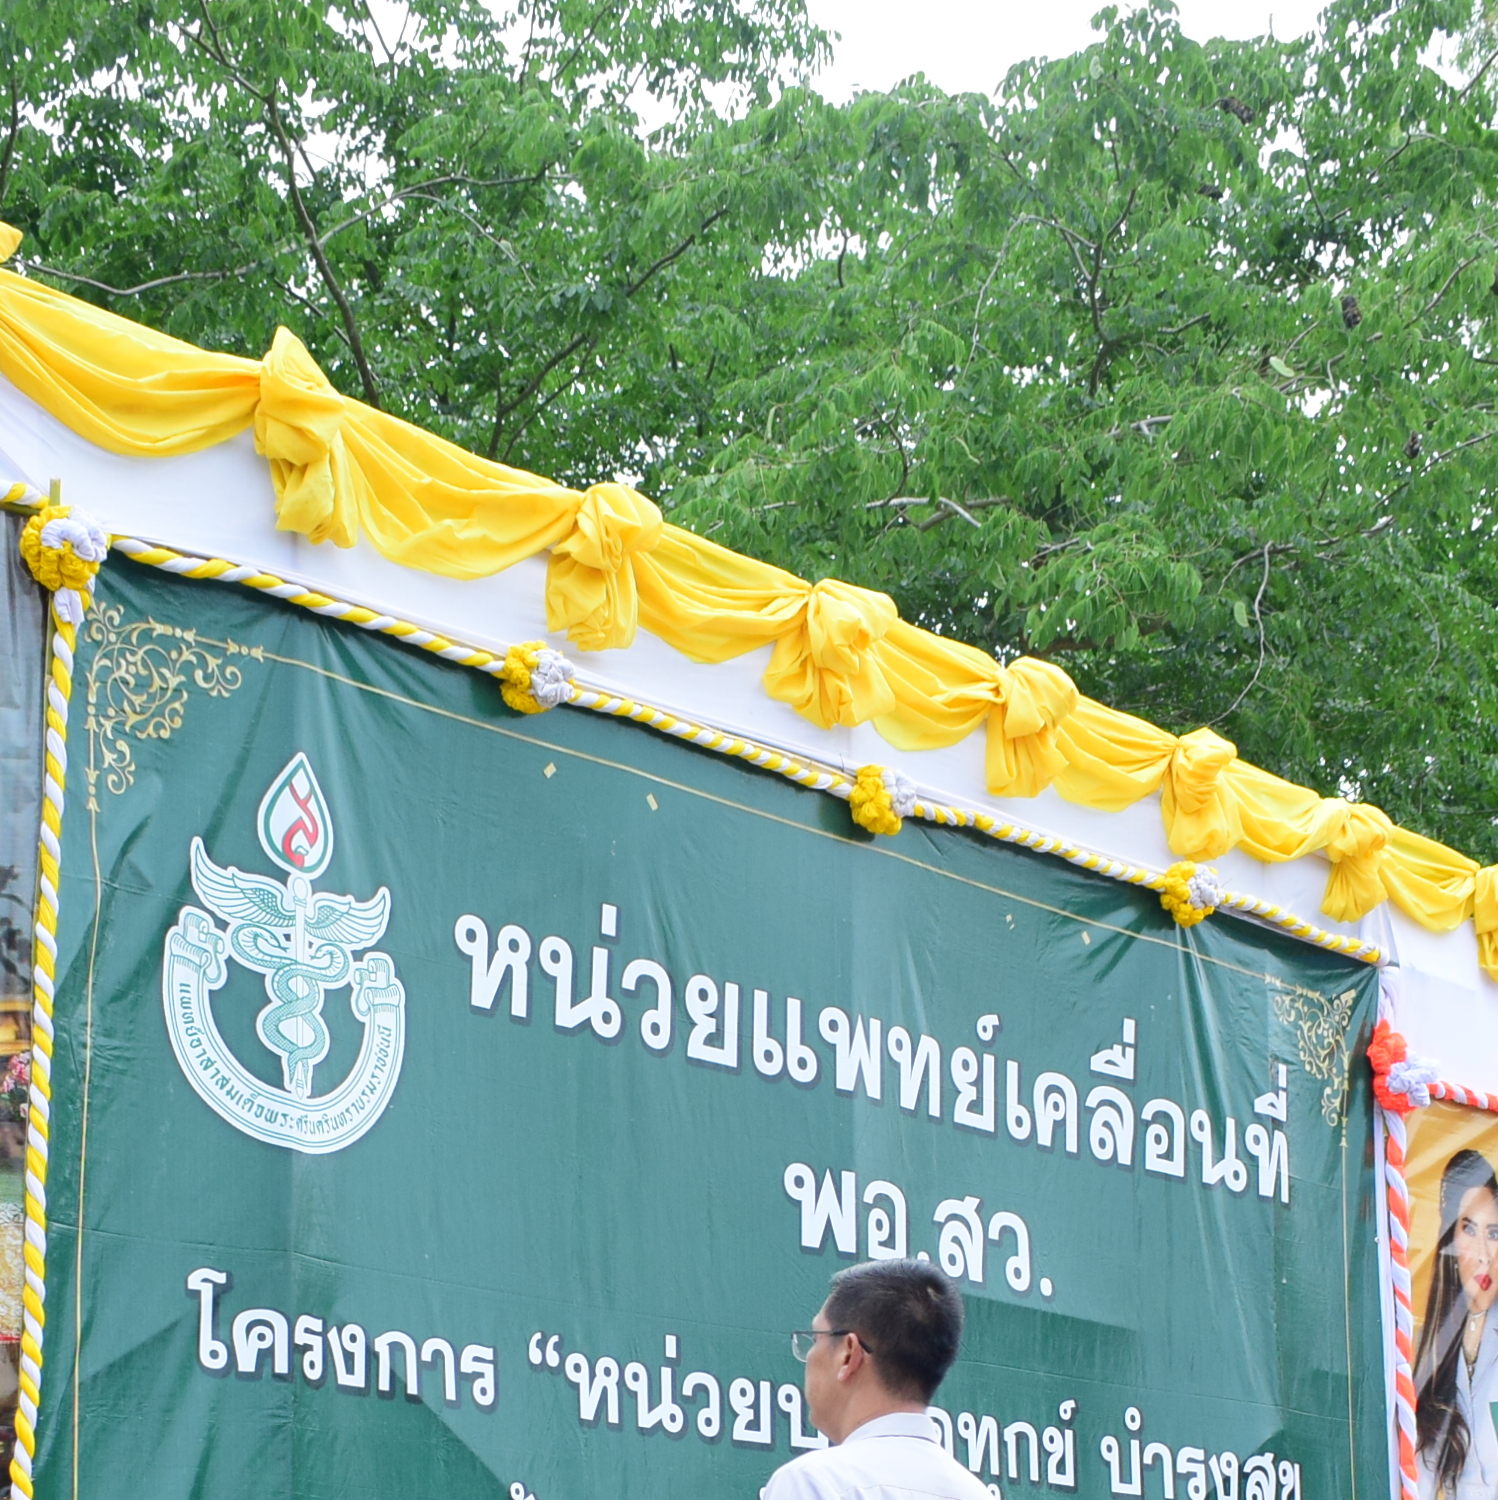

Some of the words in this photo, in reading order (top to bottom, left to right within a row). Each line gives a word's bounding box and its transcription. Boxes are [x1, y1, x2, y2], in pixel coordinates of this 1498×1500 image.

[454, 903, 1290, 1203] หน่วยแพทย์เคลื่อนที่
[784, 1163, 1054, 1297] พอ.สว.
[188, 1267, 496, 1405] โครงการ
